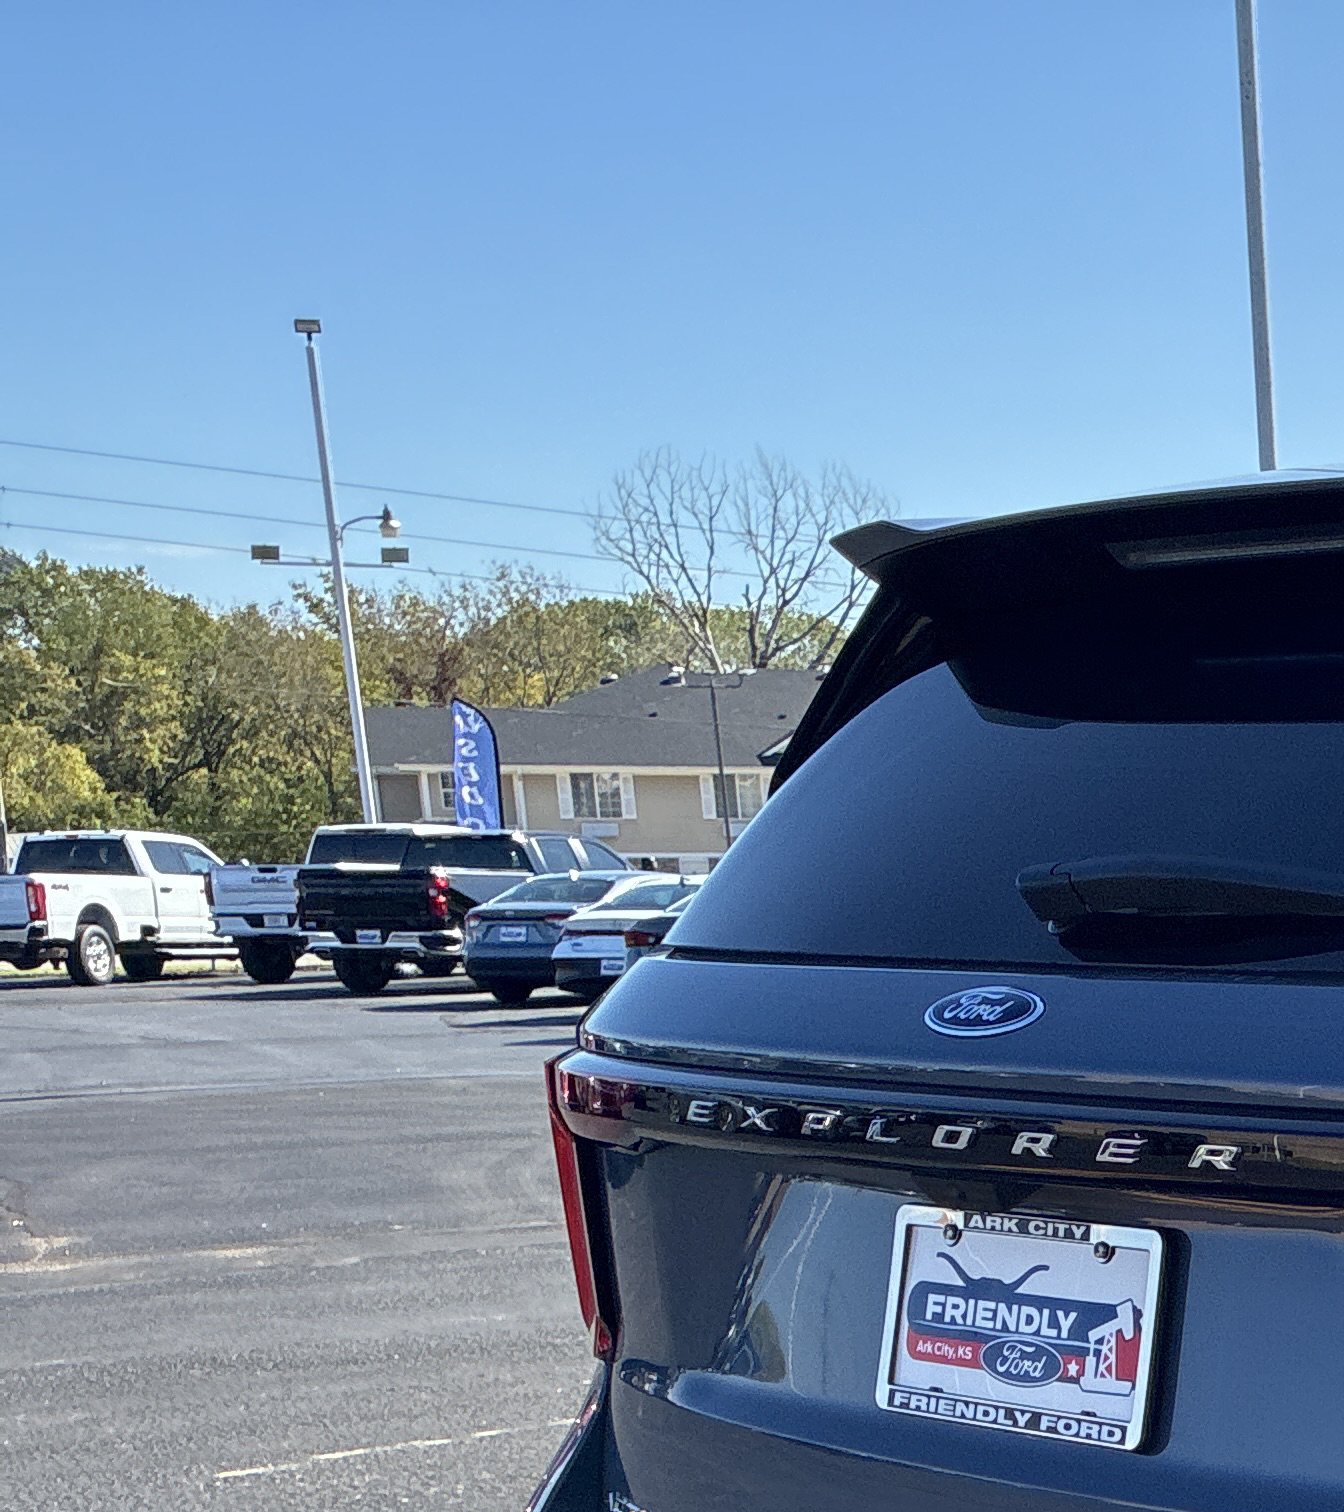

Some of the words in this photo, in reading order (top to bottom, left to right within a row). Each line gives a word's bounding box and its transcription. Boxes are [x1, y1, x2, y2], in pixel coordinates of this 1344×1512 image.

[943, 993, 1013, 1023] Ford
[686, 1099, 1241, 1171] EXPLORER
[968, 1213, 1020, 1233] ARK
[1027, 1222, 1089, 1241] CITY
[925, 1293, 1078, 1340] FRIENDLY
[916, 1340, 933, 1354] Ark
[956, 1345, 973, 1360] KS
[996, 1342, 1046, 1378] Ford
[893, 1393, 1033, 1428] FRIENDLY
[1039, 1416, 1123, 1443] FORD
